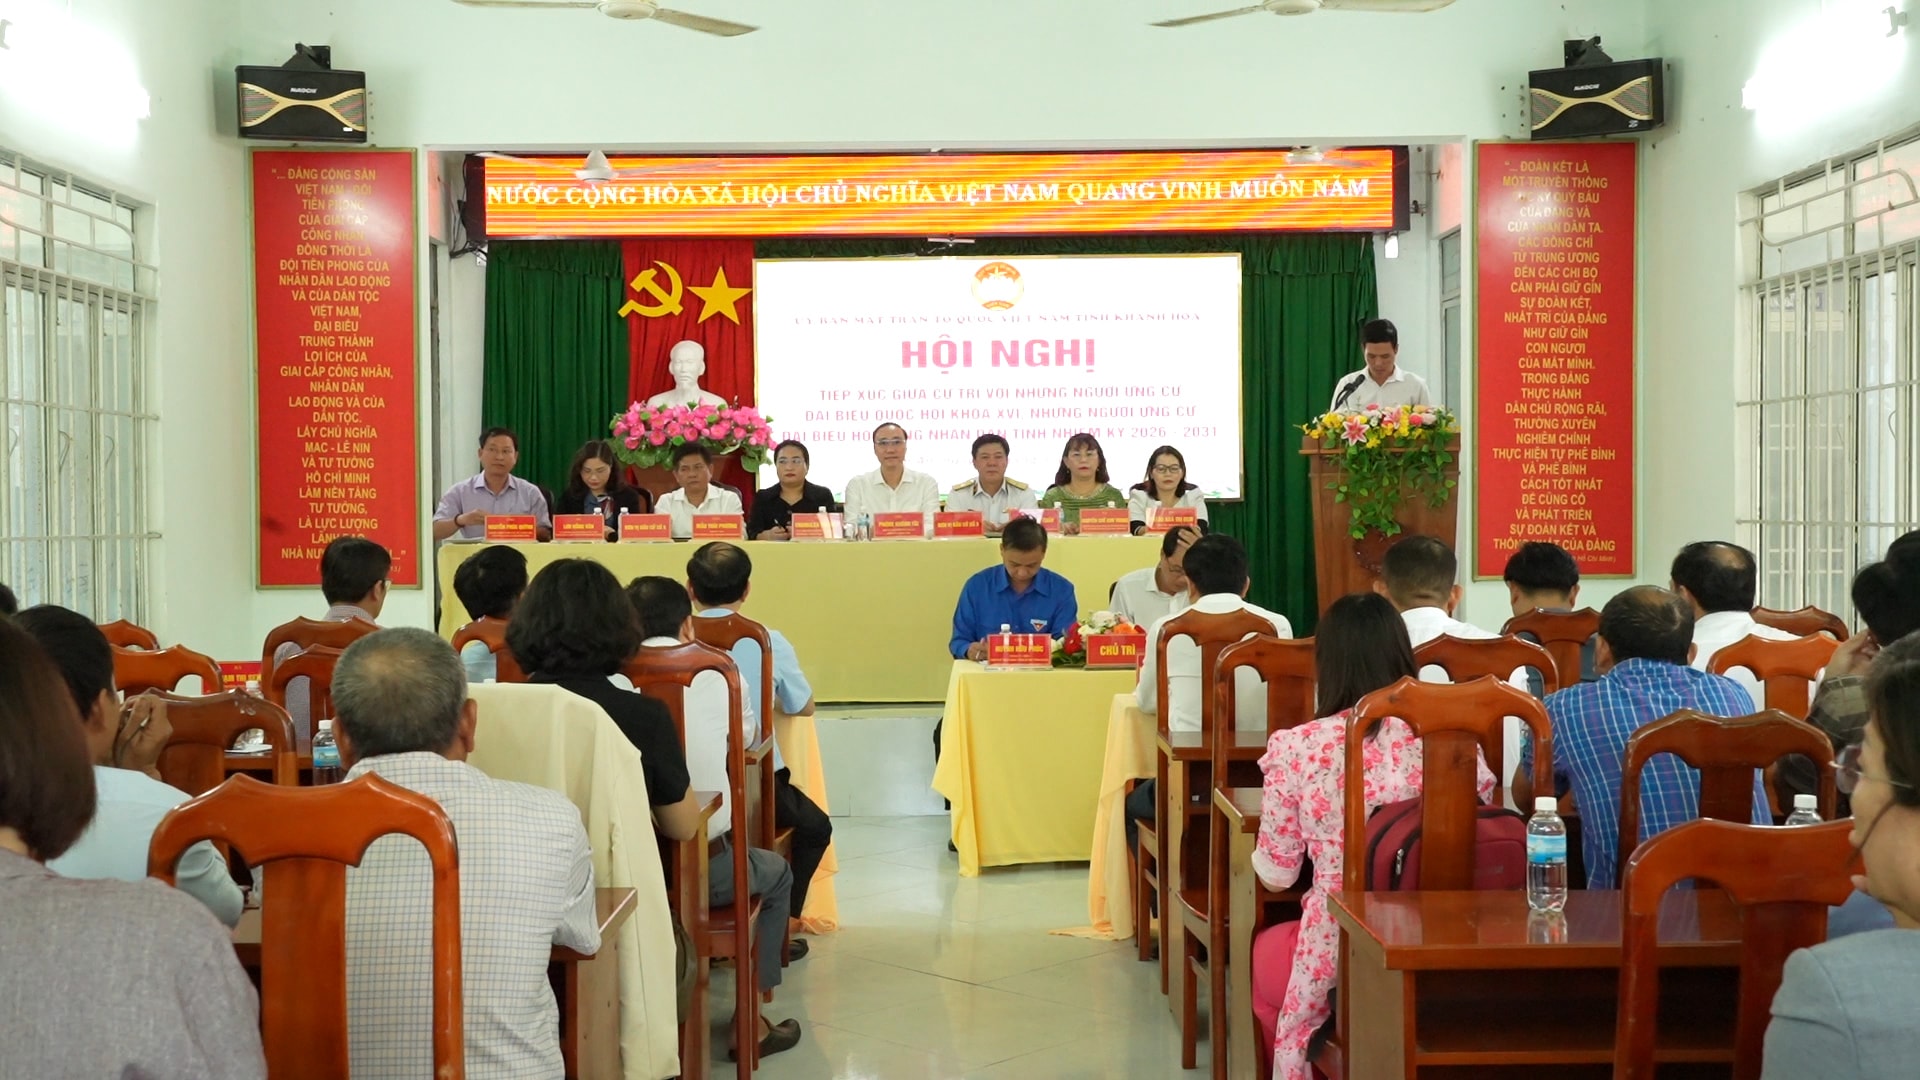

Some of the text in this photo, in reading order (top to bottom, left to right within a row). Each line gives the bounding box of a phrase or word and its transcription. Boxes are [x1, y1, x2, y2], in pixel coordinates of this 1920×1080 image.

[488, 181, 559, 204] NƯỚC
[700, 181, 732, 204] XÃ
[742, 183, 788, 208] HỘI
[795, 179, 847, 204] CHỦ
[856, 180, 935, 204] NGHĨA
[940, 181, 995, 206] VIỆT
[1003, 183, 1059, 202] NAM
[1067, 182, 1156, 205] QUANG
[1161, 181, 1222, 199] VINH
[1230, 174, 1304, 199] MUÔN
[1312, 176, 1370, 199] NĂM
[1530, 252, 1565, 263] TRUNG
[327, 261, 364, 272] PHONG
[1563, 268, 1580, 278] CHI
[336, 276, 357, 286] LAO
[314, 321, 332, 334] ĐẠI
[300, 336, 336, 347] TRUNG
[1526, 343, 1548, 353] CON
[902, 334, 1095, 374] HỘI NGHỊ
[280, 366, 301, 377] GIAI
[1521, 373, 1557, 384] TRONG
[289, 396, 310, 407] LAO
[346, 394, 360, 408] VÀ
[363, 394, 385, 408] CỦA
[345, 425, 378, 438] NGHĨA
[1132, 426, 1217, 438] 2026 2031
[353, 443, 370, 453] NIN
[302, 454, 316, 468] VÀ
[319, 457, 334, 468] TƯ
[344, 473, 370, 483] MINH
[300, 485, 321, 498] LÀM
[310, 502, 324, 513] TƯ
[299, 515, 312, 528] LÀ
[282, 545, 303, 559] NHÀ
[1100, 641, 1136, 656] CHỦ TRÌ
